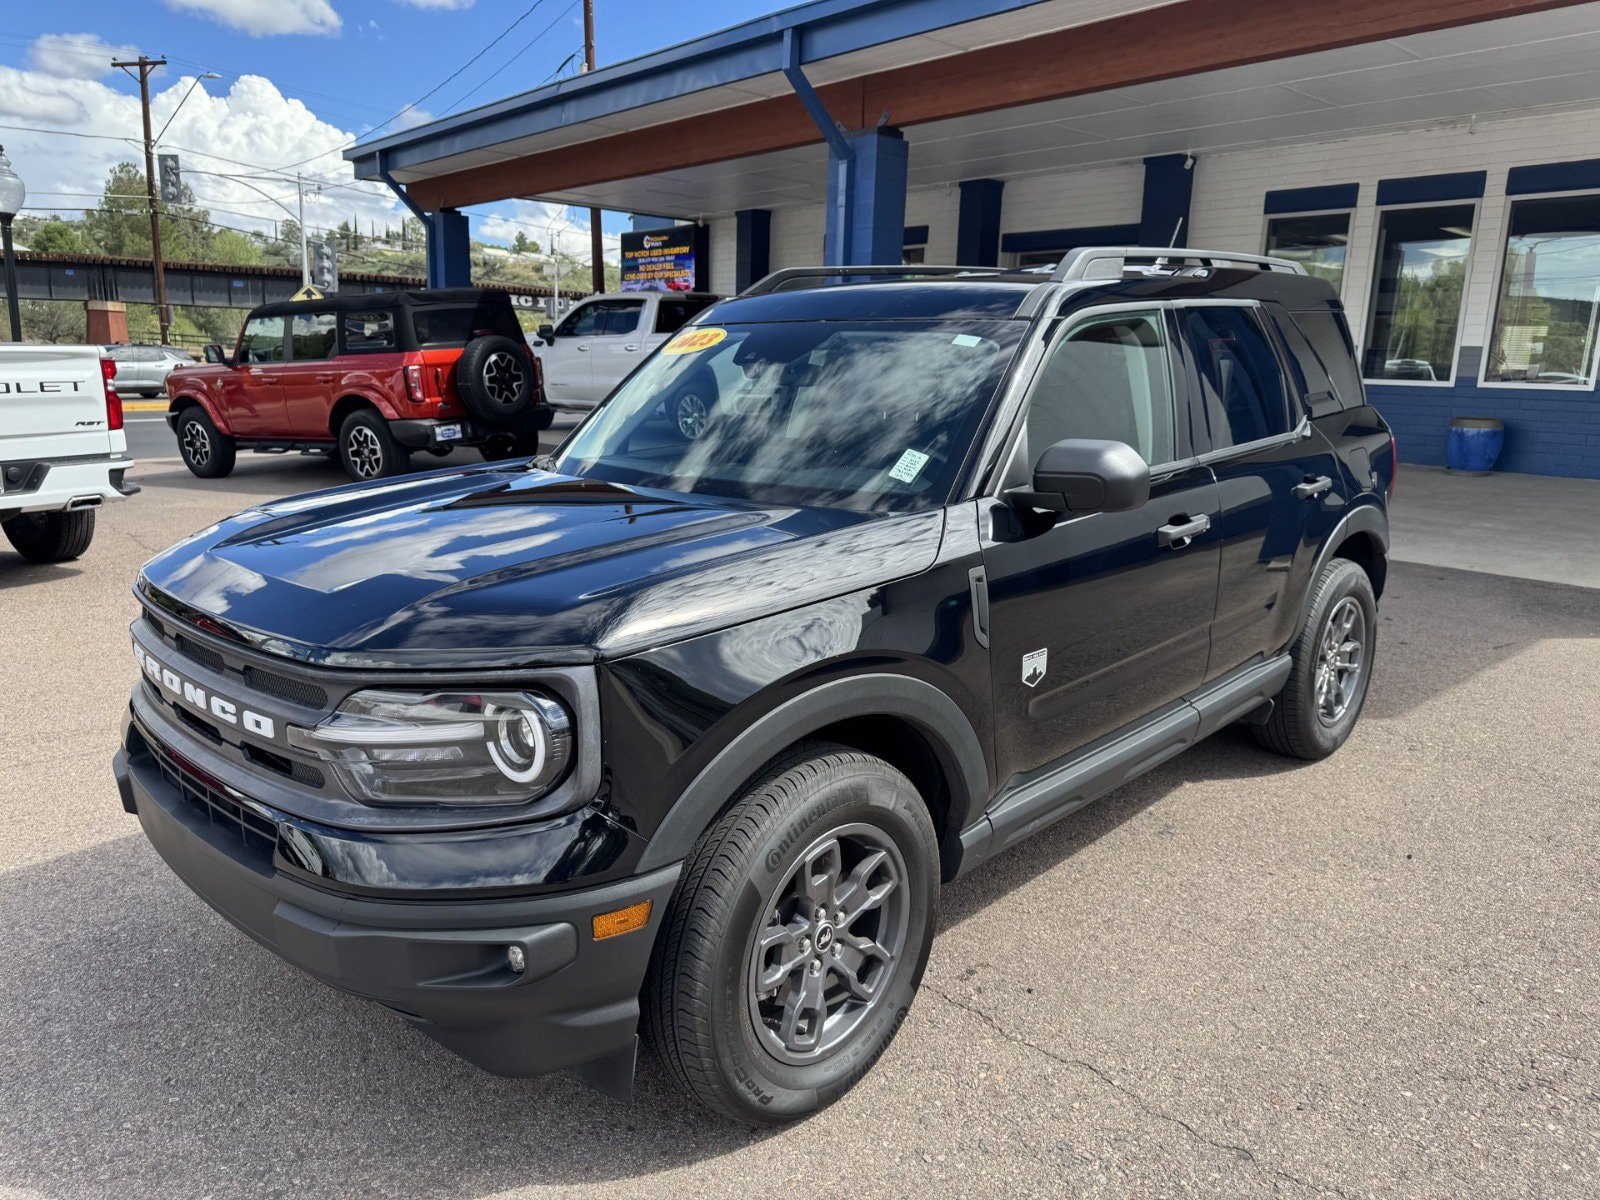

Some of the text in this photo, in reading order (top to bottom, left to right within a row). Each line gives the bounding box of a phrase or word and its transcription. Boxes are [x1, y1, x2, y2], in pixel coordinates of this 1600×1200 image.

[664, 246, 690, 255] INVENTORY
[668, 332, 721, 349] 2023
[133, 642, 275, 739] BRONCO
